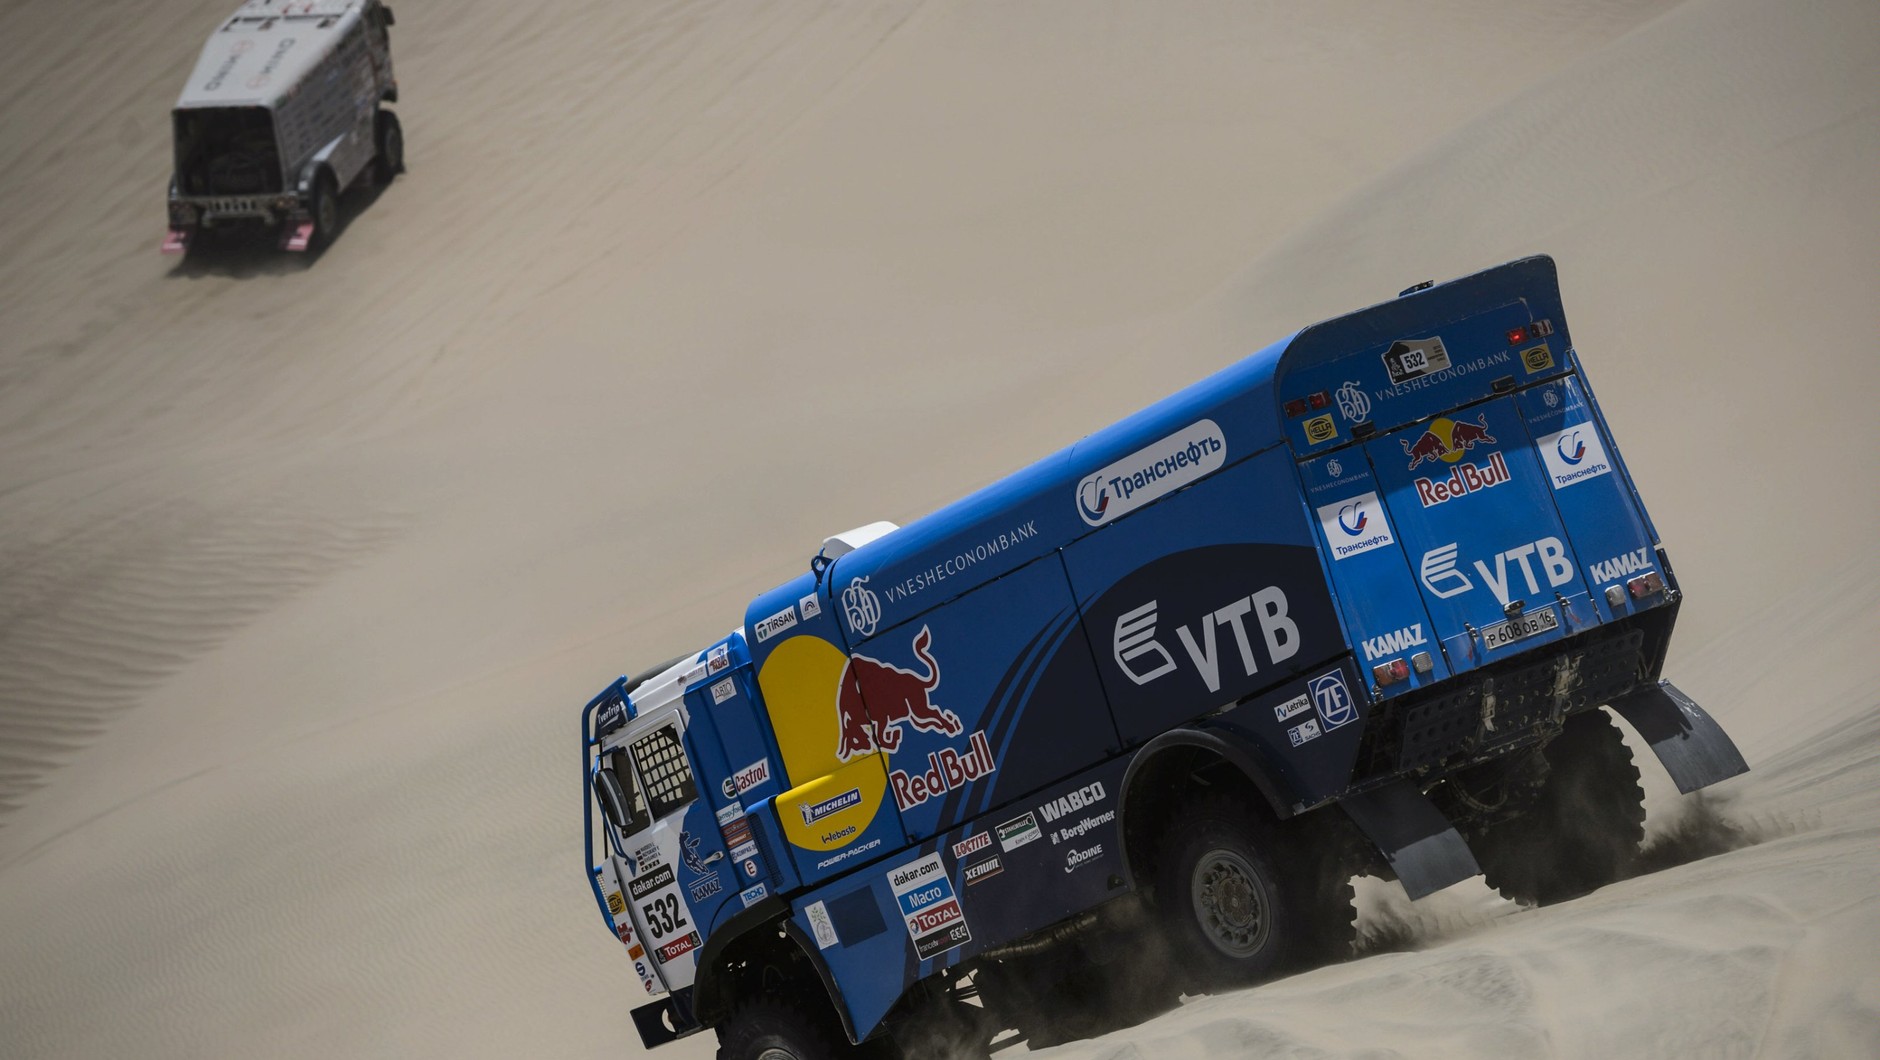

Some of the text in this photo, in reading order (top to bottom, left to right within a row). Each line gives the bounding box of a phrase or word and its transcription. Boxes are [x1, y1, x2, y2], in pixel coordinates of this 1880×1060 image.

[1404, 350, 1426, 370] 532
[1526, 349, 1550, 365] HELLA
[1375, 350, 1511, 402] VNESHECONOMBANK
[1309, 422, 1333, 437] HELLA
[1109, 436, 1222, 500] Транснефть
[1555, 462, 1607, 485] Транснефть
[1336, 533, 1389, 556] Транснефть
[885, 520, 1038, 603] VNESHECONOMBANK
[1473, 536, 1574, 606] VTB
[1590, 547, 1653, 585] KAMAZ
[1176, 585, 1300, 693] VTB
[1362, 624, 1427, 661] KAMAZ
[1286, 697, 1309, 713] Letrika
[1317, 685, 1350, 717] ZF
[735, 763, 767, 792] Castrol
[815, 792, 859, 817] MICHELIN
[1039, 781, 1106, 823] WABCO
[821, 825, 856, 845] Webasto
[1061, 809, 1115, 841] BorgWarner
[955, 833, 990, 857] LOCTITE
[1067, 844, 1103, 866] MODINE
[894, 861, 940, 886] dakar.com
[965, 858, 1000, 881] XENUM
[633, 870, 672, 896] dakar.com
[691, 877, 721, 902] KAMAZ
[743, 887, 764, 901] TECHO
[909, 887, 941, 909] Macro
[643, 893, 687, 939] 532
[920, 908, 959, 927] TOTAL
[664, 940, 692, 957] TOTAL
